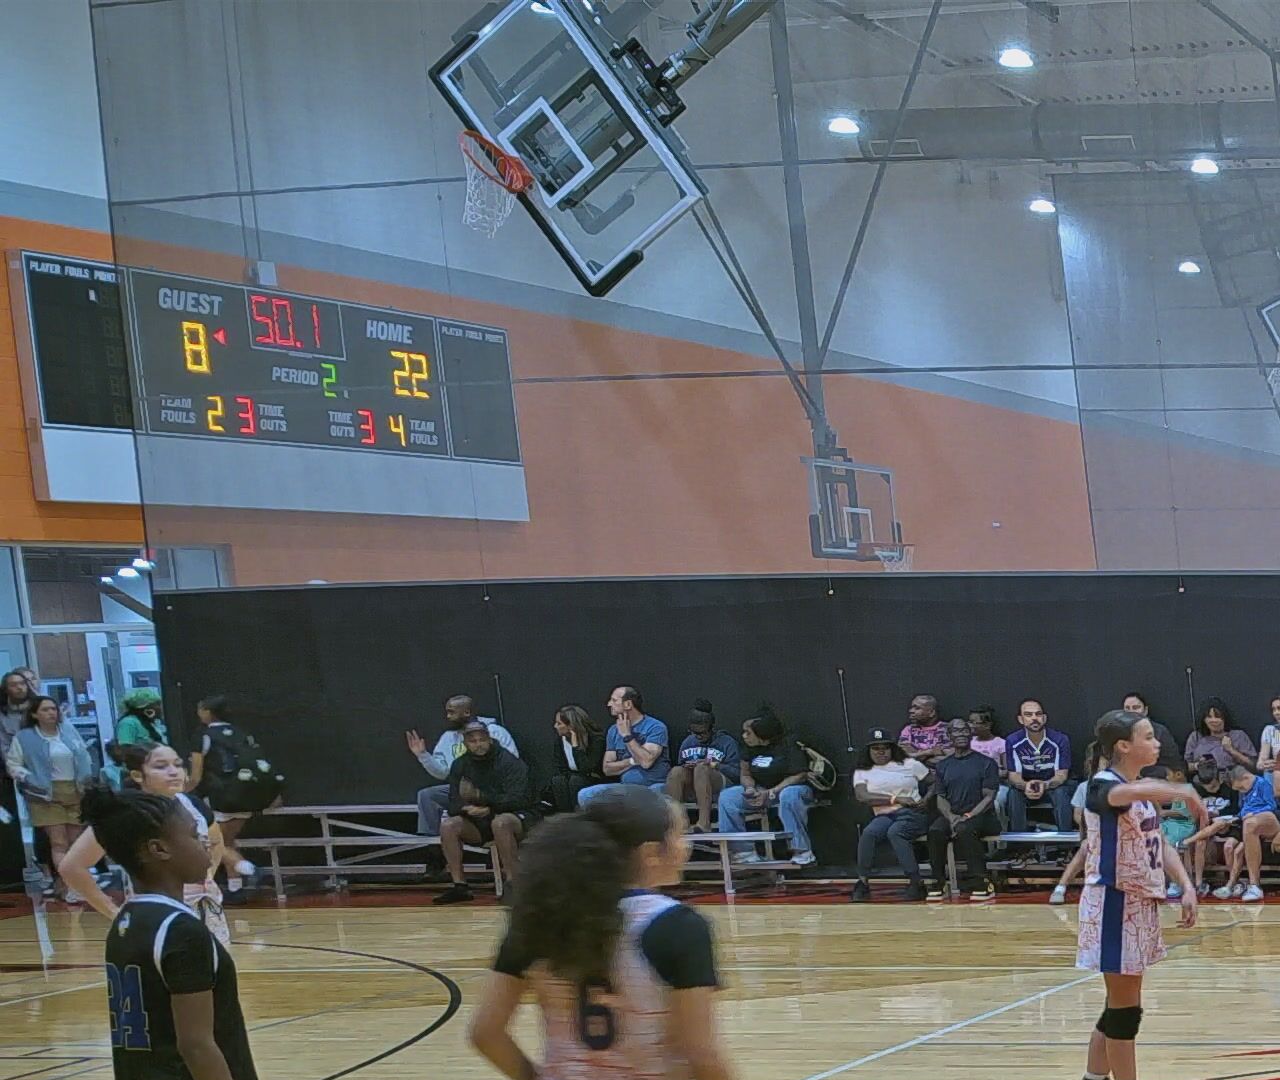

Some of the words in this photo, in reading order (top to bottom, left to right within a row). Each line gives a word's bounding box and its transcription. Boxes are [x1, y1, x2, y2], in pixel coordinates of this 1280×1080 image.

[158, 287, 223, 316] GUEST
[250, 294, 322, 349] 50.1
[366, 319, 414, 345] HOME
[182, 321, 212, 374] 8
[271, 366, 319, 386] PERIOD
[320, 362, 337, 398] 2
[390, 350, 430, 399] 22
[160, 394, 192, 409] TEAM
[206, 396, 226, 432] 2
[235, 397, 256, 434] 3
[257, 403, 285, 417] TIME
[160, 410, 196, 424] FOULS
[260, 419, 288, 432] OUTS
[327, 410, 353, 425] TIME
[356, 409, 376, 445] 3
[388, 414, 407, 448] 4
[409, 419, 435, 433] TEAM
[410, 433, 438, 446] FOULS
